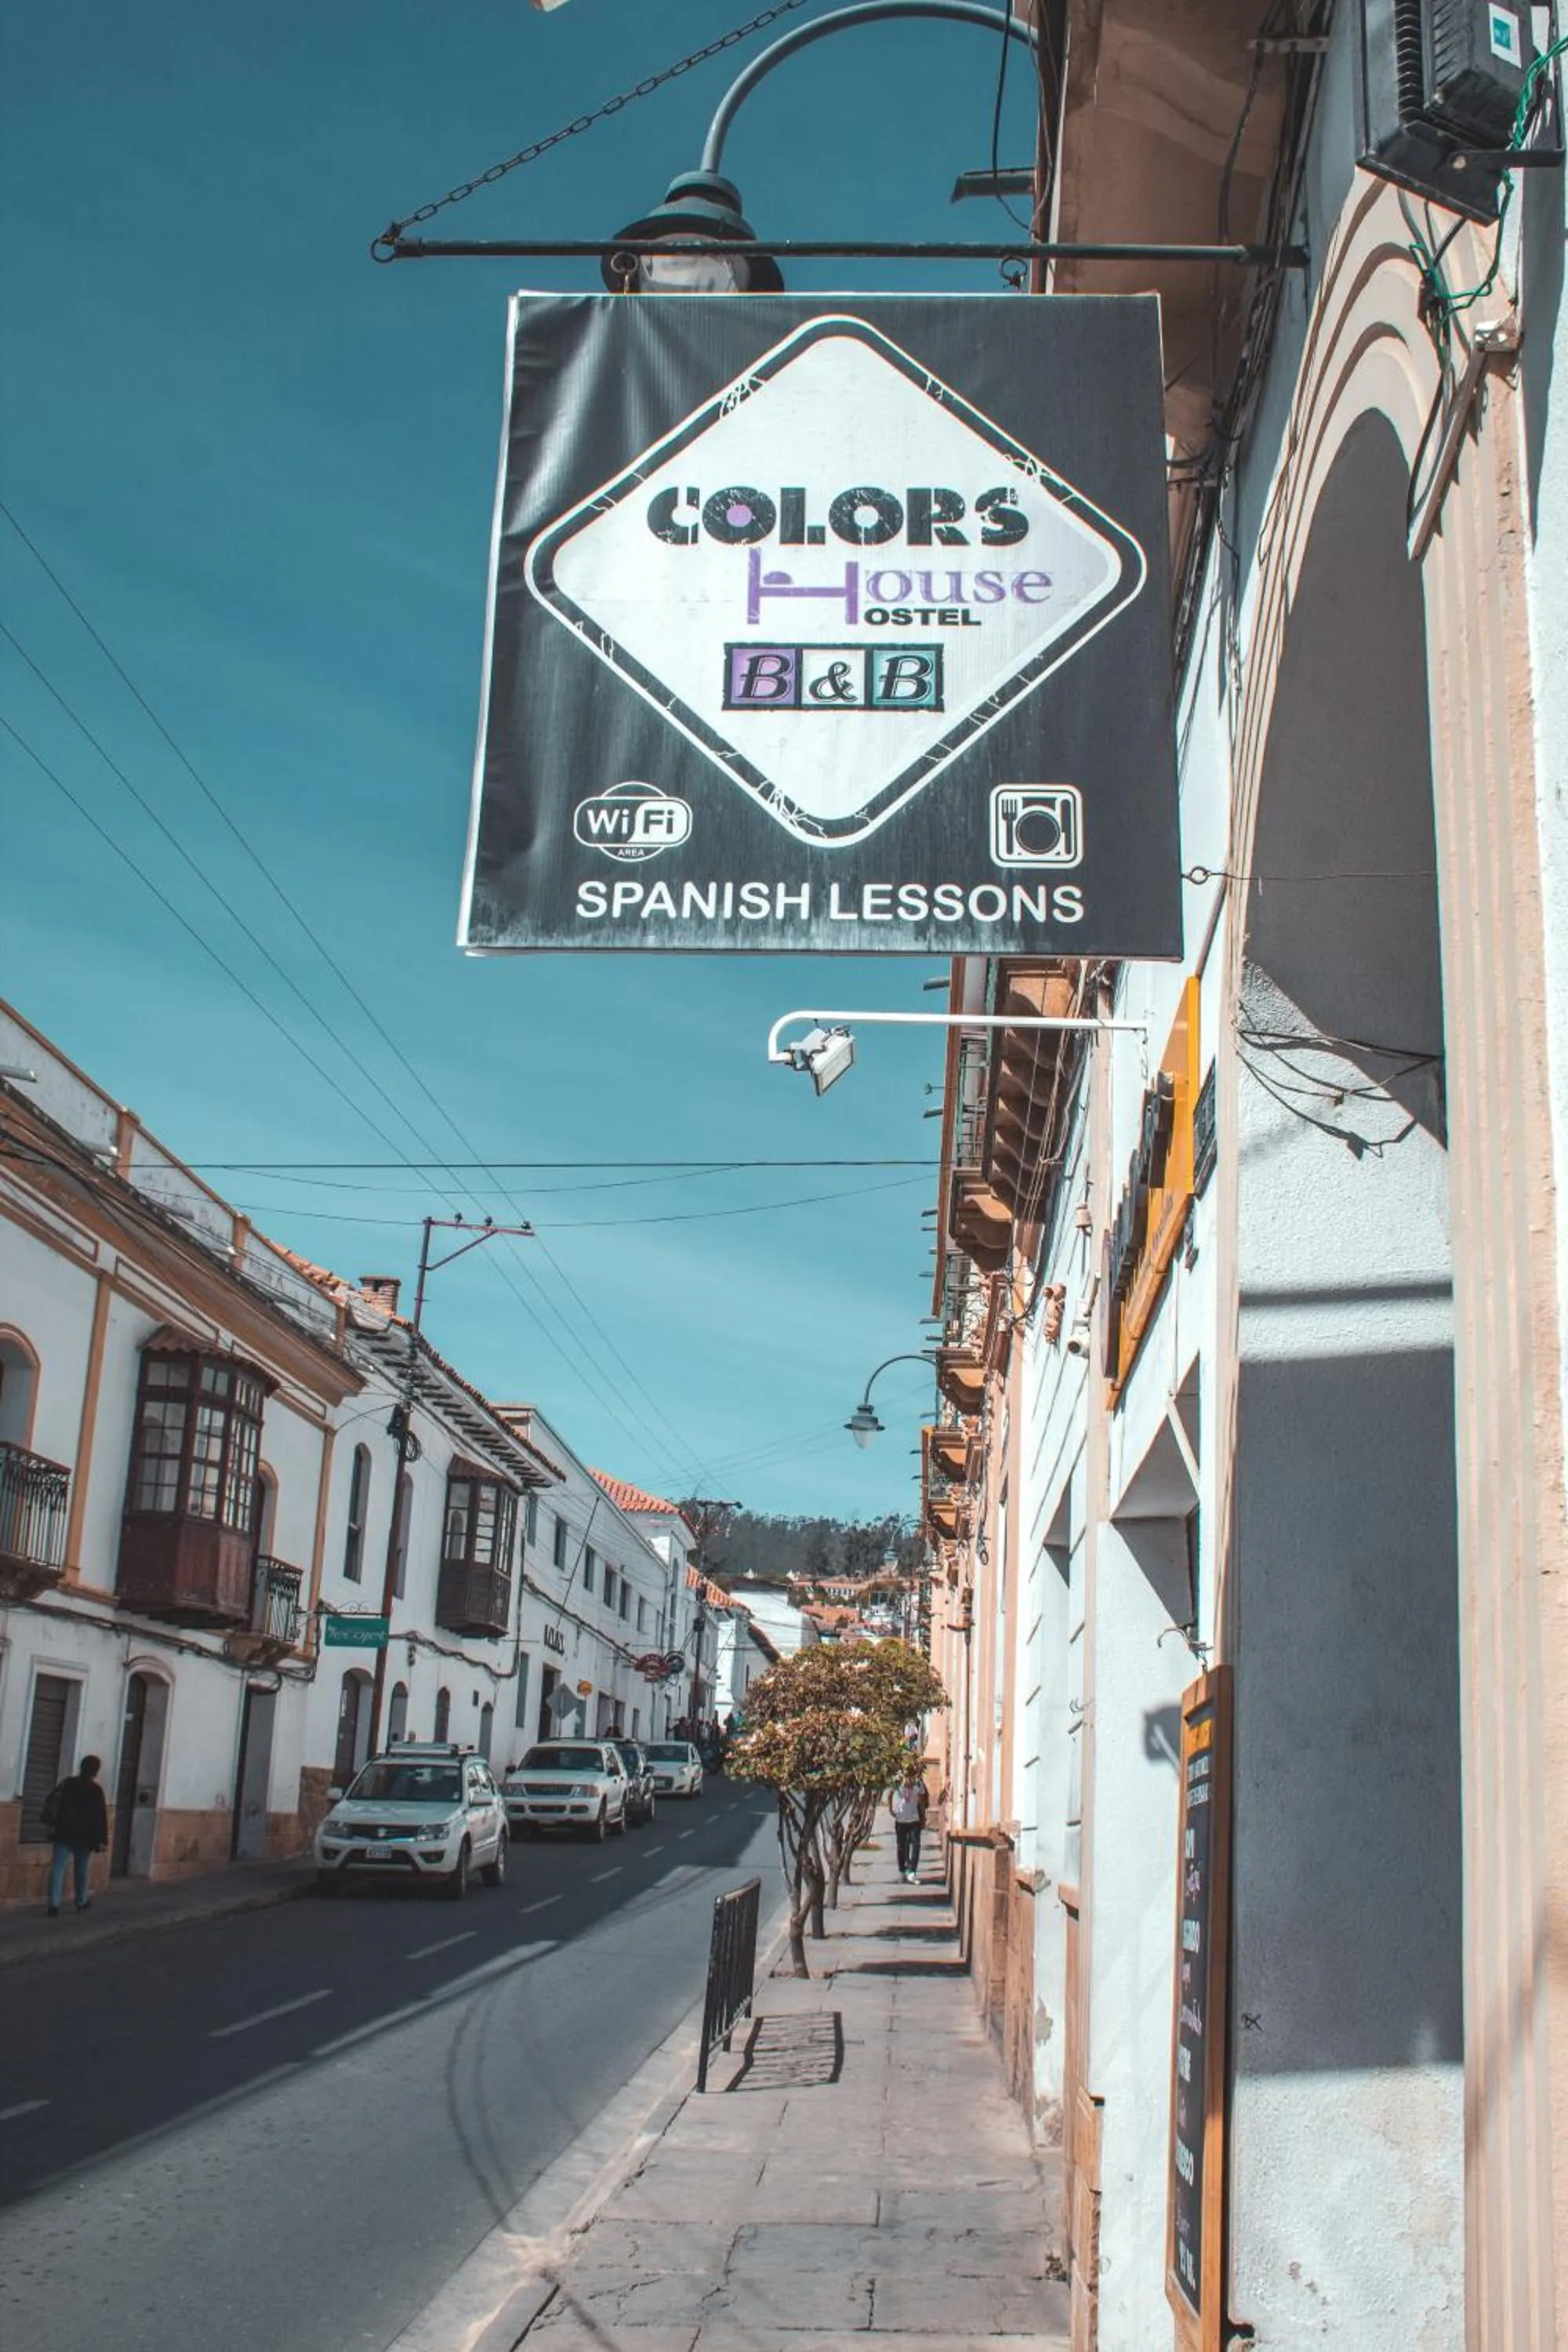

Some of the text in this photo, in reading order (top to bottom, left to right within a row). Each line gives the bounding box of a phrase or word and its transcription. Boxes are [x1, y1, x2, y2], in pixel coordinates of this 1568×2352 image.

[647, 486, 1029, 546] COLORS
[617, 848, 645, 857] AREA
[575, 880, 1084, 923] SPANISH LESSONS
